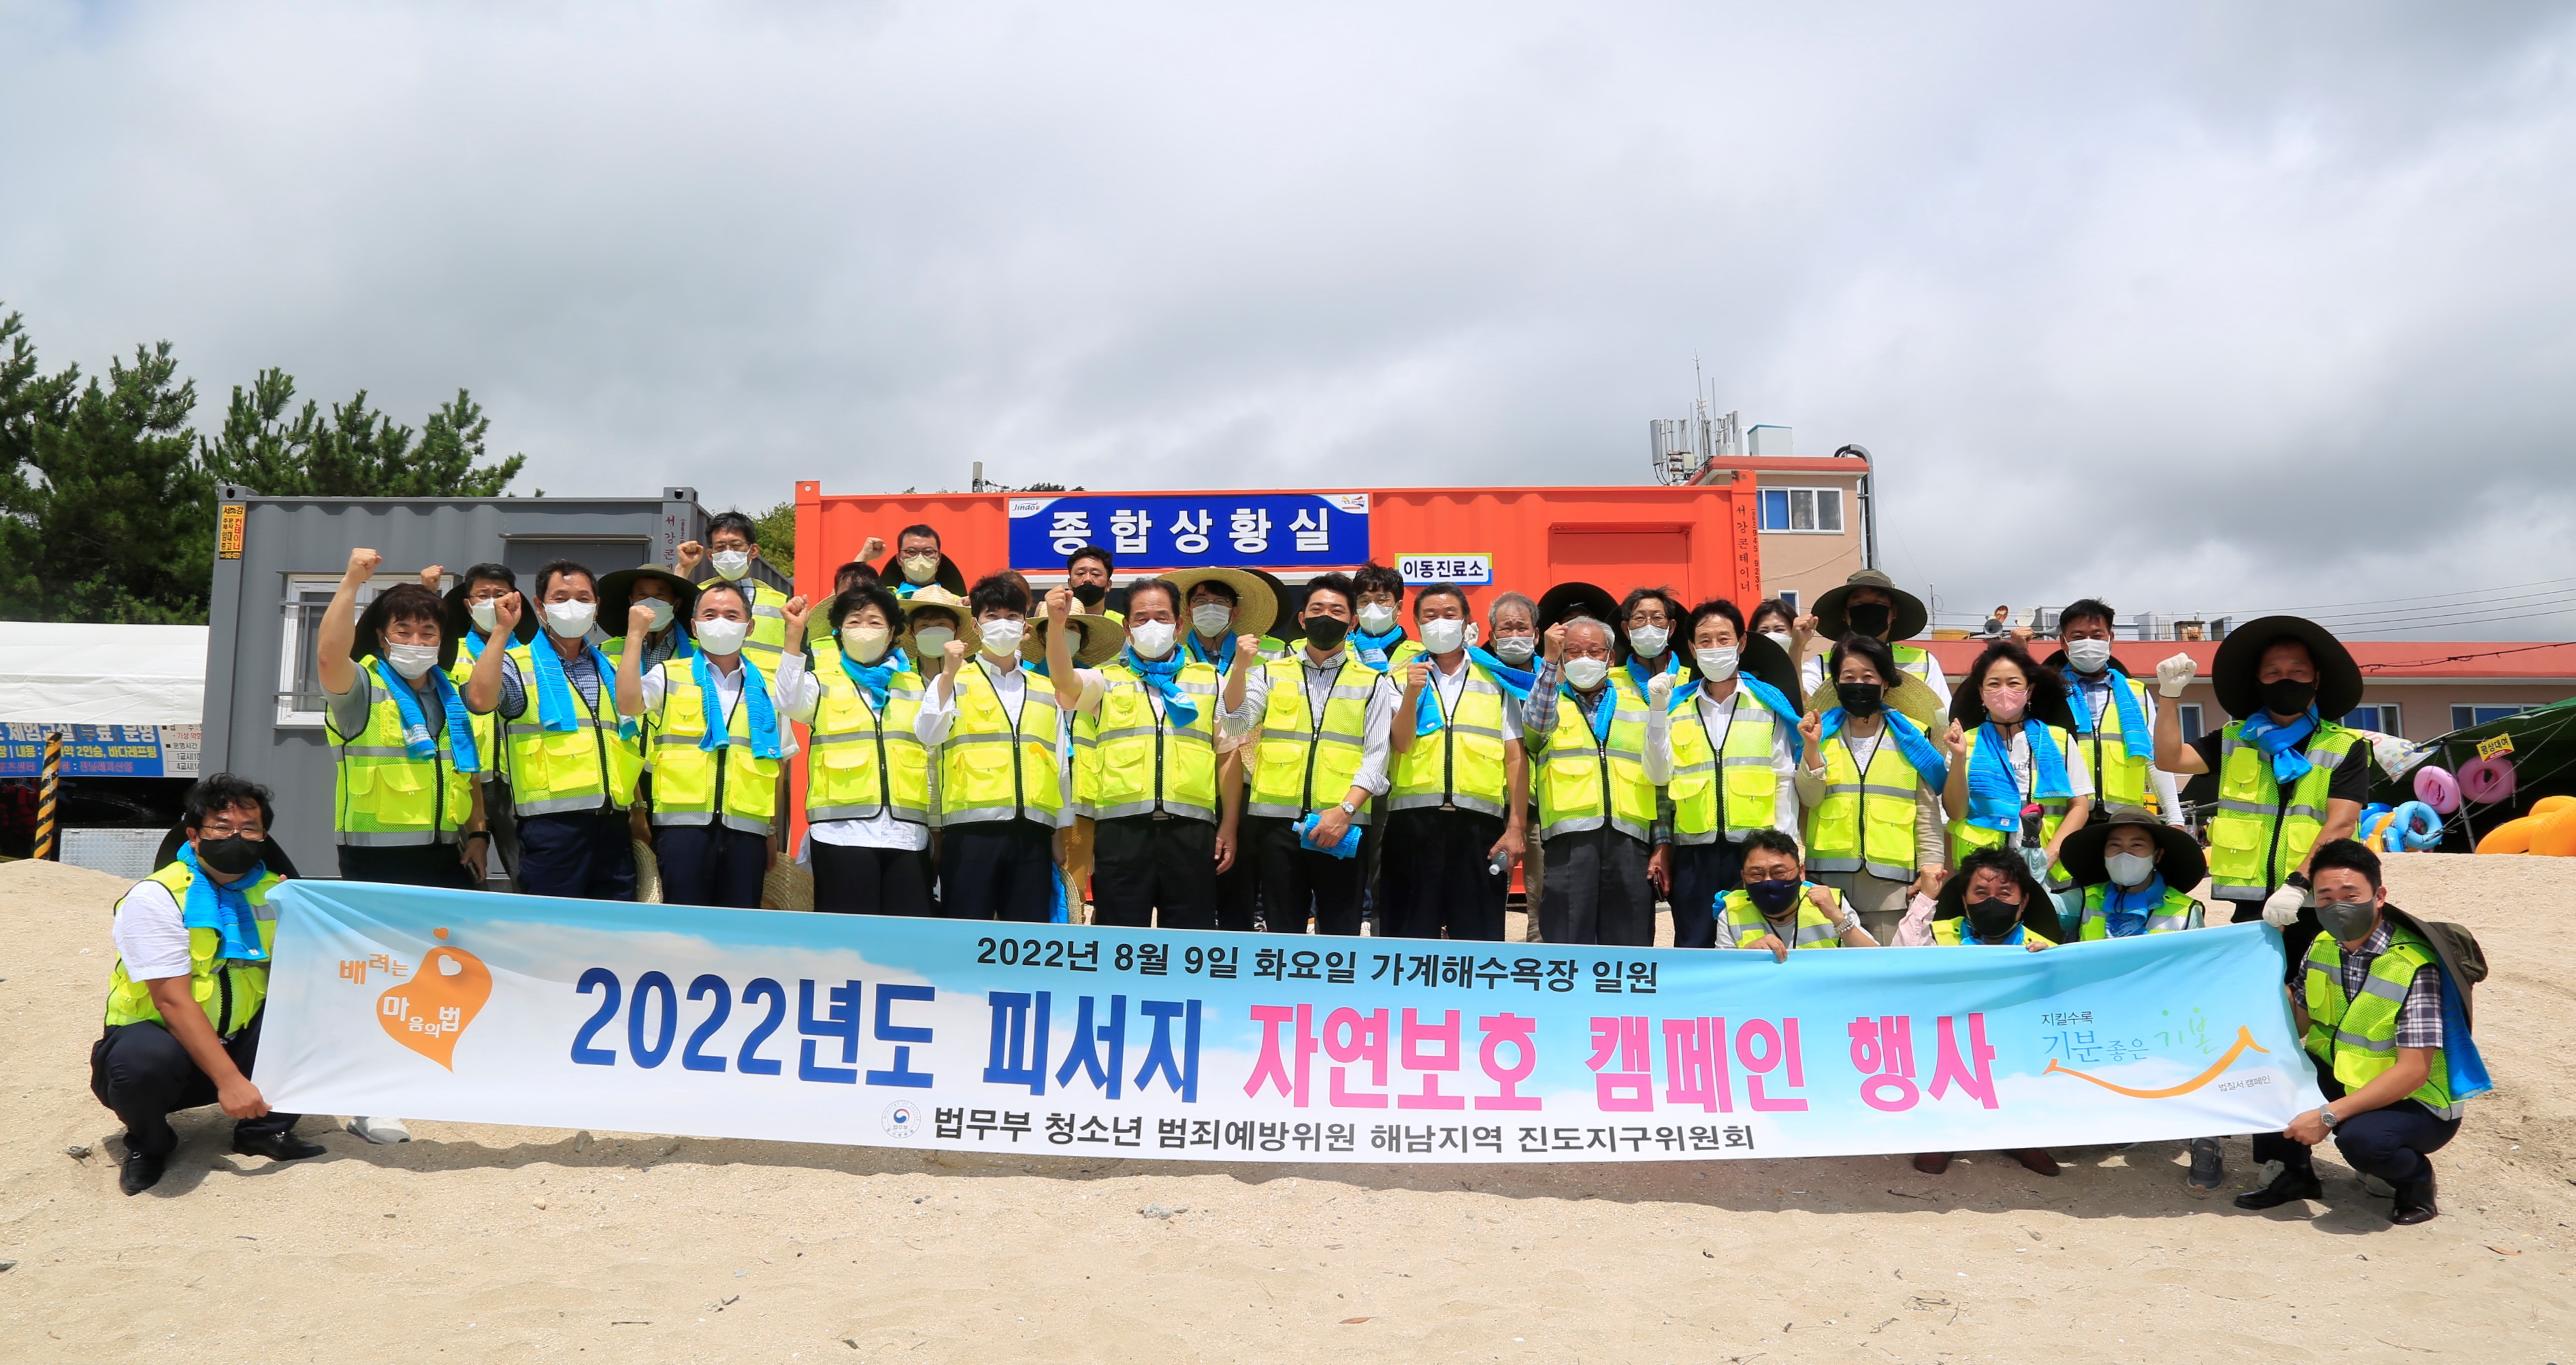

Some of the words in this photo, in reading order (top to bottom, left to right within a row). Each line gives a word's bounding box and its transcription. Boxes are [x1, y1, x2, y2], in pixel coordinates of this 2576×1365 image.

[233, 518, 243, 550] 컨테이너
[1049, 508, 1330, 556] 종합상황실
[1736, 505, 1750, 592] 서강콘테이너
[1403, 560, 1484, 578] 이동진료소
[122, 725, 156, 743] 운영
[2481, 737, 2509, 755] 평상대여
[339, 953, 409, 985] 배려는
[977, 937, 1099, 972] 2022년
[1114, 942, 1169, 976] 8월
[1184, 946, 1239, 979] 9일
[1254, 948, 1356, 984] 화요일
[1371, 953, 1578, 993] 가계해수욕장
[1593, 960, 1657, 994] 일원
[2042, 1010, 2094, 1026] 지킬수록
[570, 967, 936, 1089] 2022년도
[983, 991, 1203, 1104] 피서지
[1243, 1003, 1542, 1111] 자연보호
[1584, 1016, 1809, 1113] 캠페인
[1848, 1013, 2000, 1112] 행사
[2042, 1030, 2103, 1064] 기분
[2106, 1038, 2149, 1062] 좋은
[2218, 1081, 2245, 1093] 법질서
[2245, 1074, 2272, 1089] 캠페인
[934, 1107, 1032, 1142] 법무부
[1045, 1113, 1143, 1147] 청소년
[1158, 1118, 1356, 1152] 범죄예방위원
[1370, 1124, 1502, 1153] 해남지역
[1518, 1125, 1755, 1153] 진도지구위원회
